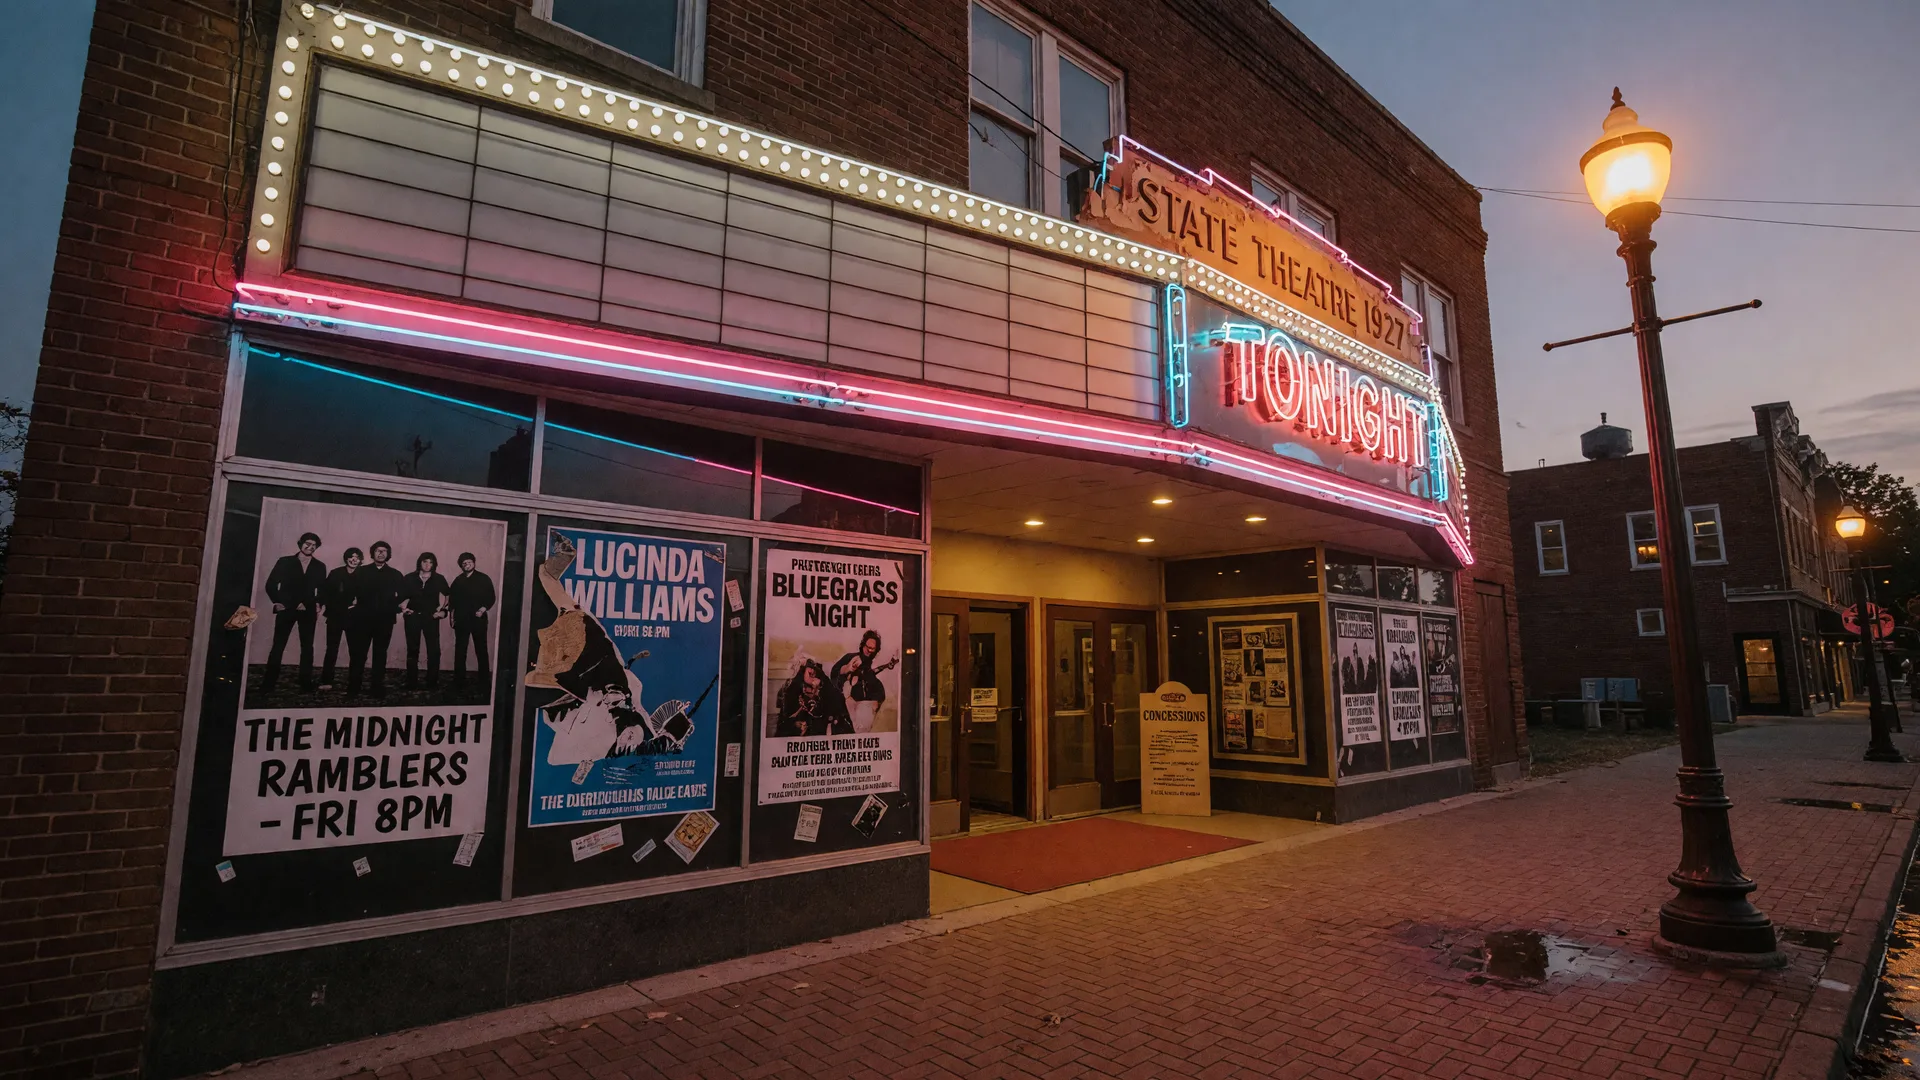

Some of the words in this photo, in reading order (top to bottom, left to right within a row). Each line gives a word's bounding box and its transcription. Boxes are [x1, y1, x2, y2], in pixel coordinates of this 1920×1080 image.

[1137, 177, 1239, 264] STATE
[1251, 235, 1358, 328] THEATRE
[1364, 299, 1405, 351] 1927
[1222, 322, 1428, 468] TONIGHT
[575, 538, 706, 584] LUCINDA
[564, 578, 716, 623] WILLIAMS
[772, 572, 898, 605] BLUEGRASS
[804, 602, 871, 629] NIGHT
[244, 718, 313, 752] THE
[323, 713, 488, 750] MIDNIGHT
[1143, 709, 1206, 722] CONCESSIONS
[257, 751, 469, 797] RAMBLERS
[292, 800, 358, 840] FRI
[374, 793, 453, 834] 8PM
[540, 795, 565, 811] THE
